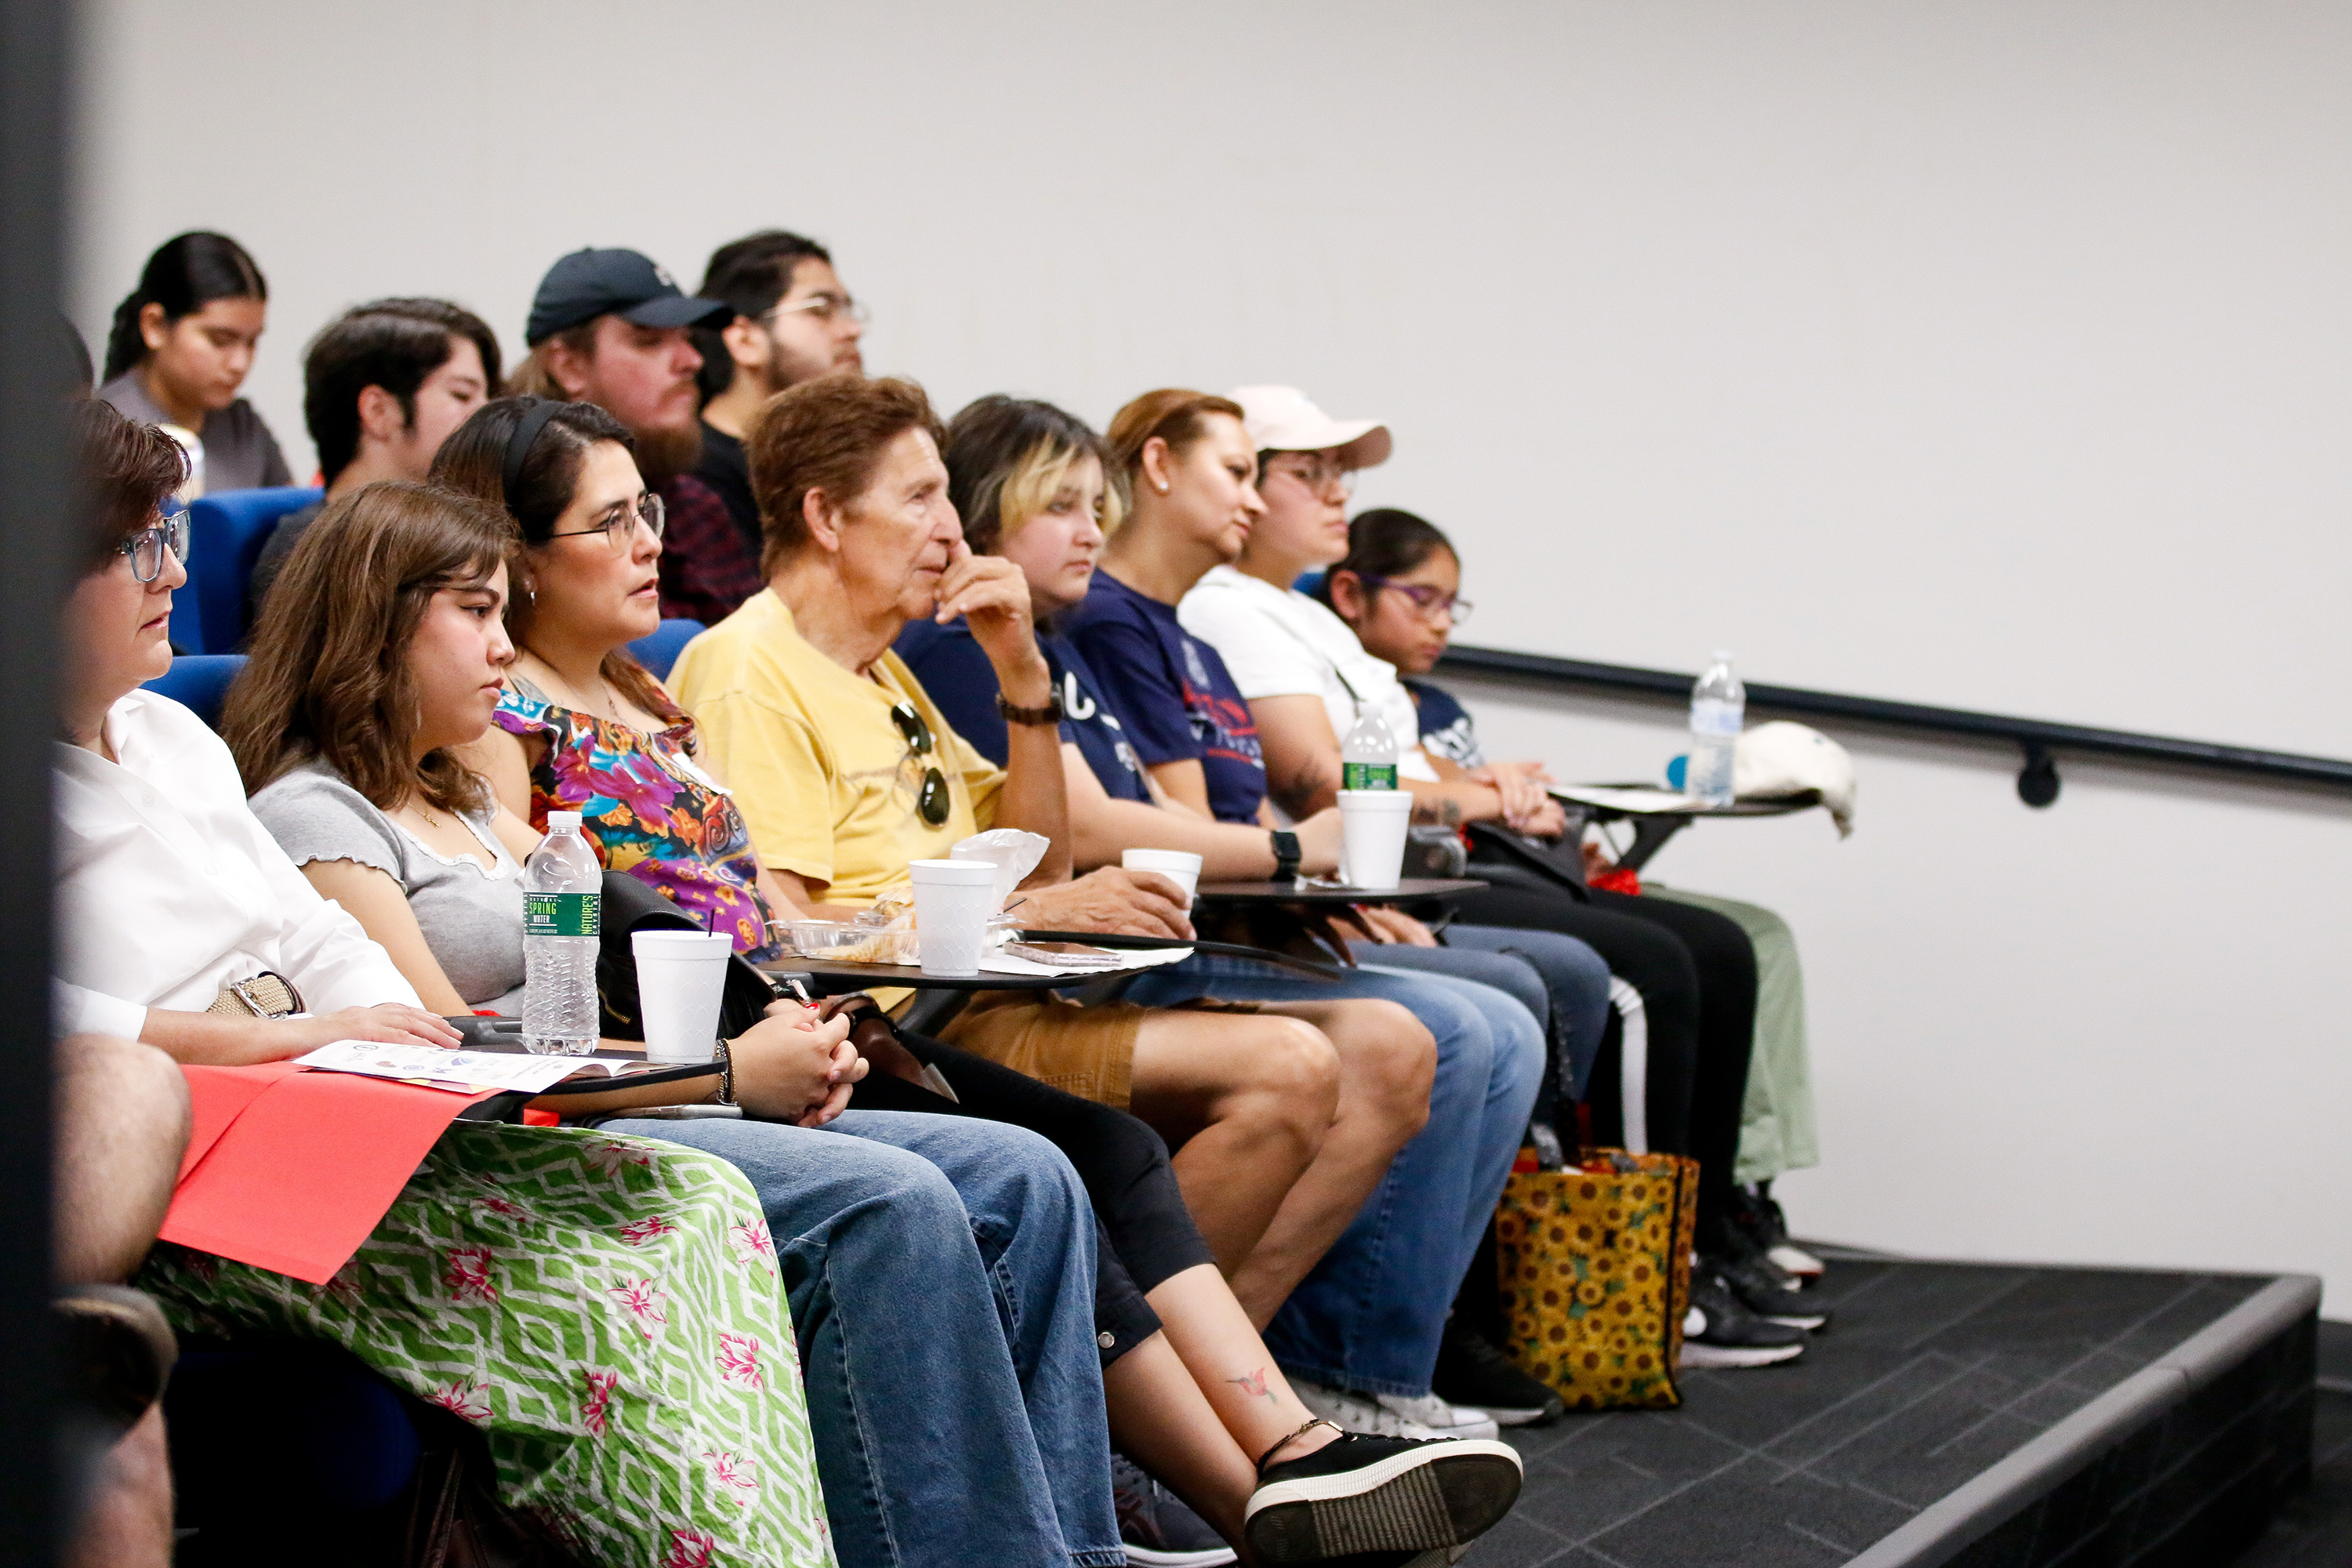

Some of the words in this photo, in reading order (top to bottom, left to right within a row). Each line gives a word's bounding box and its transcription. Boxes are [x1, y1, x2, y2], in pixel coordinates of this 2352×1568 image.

[529, 902, 557, 915] SPRING
[582, 895, 593, 935] NATURE'S
[533, 914, 550, 924] WATER
